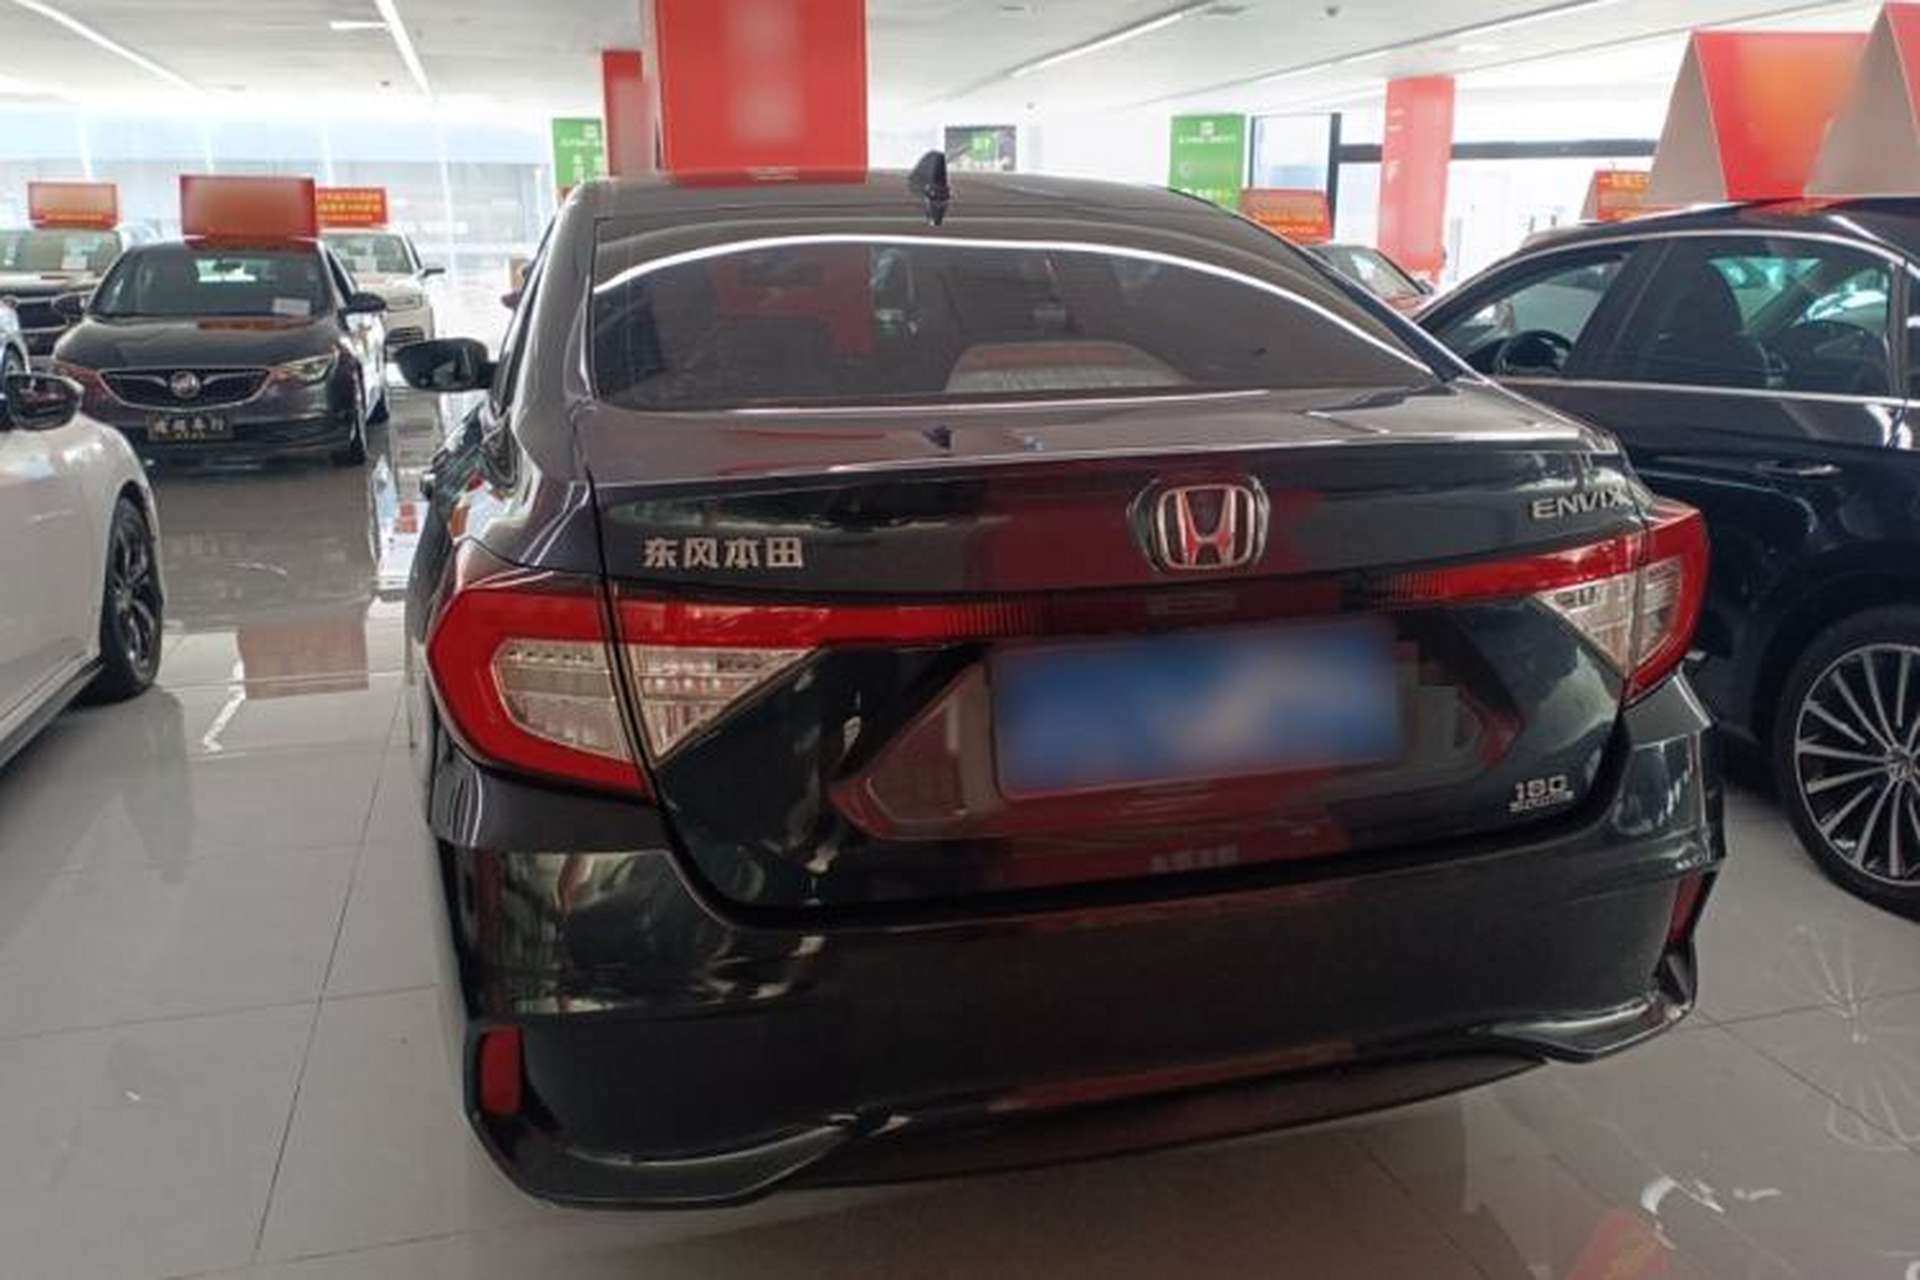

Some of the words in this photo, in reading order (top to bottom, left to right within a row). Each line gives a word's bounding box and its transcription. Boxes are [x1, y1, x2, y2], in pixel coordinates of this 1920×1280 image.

[1532, 487, 1634, 519] ENVIX
[643, 537, 804, 569] 东风本田
